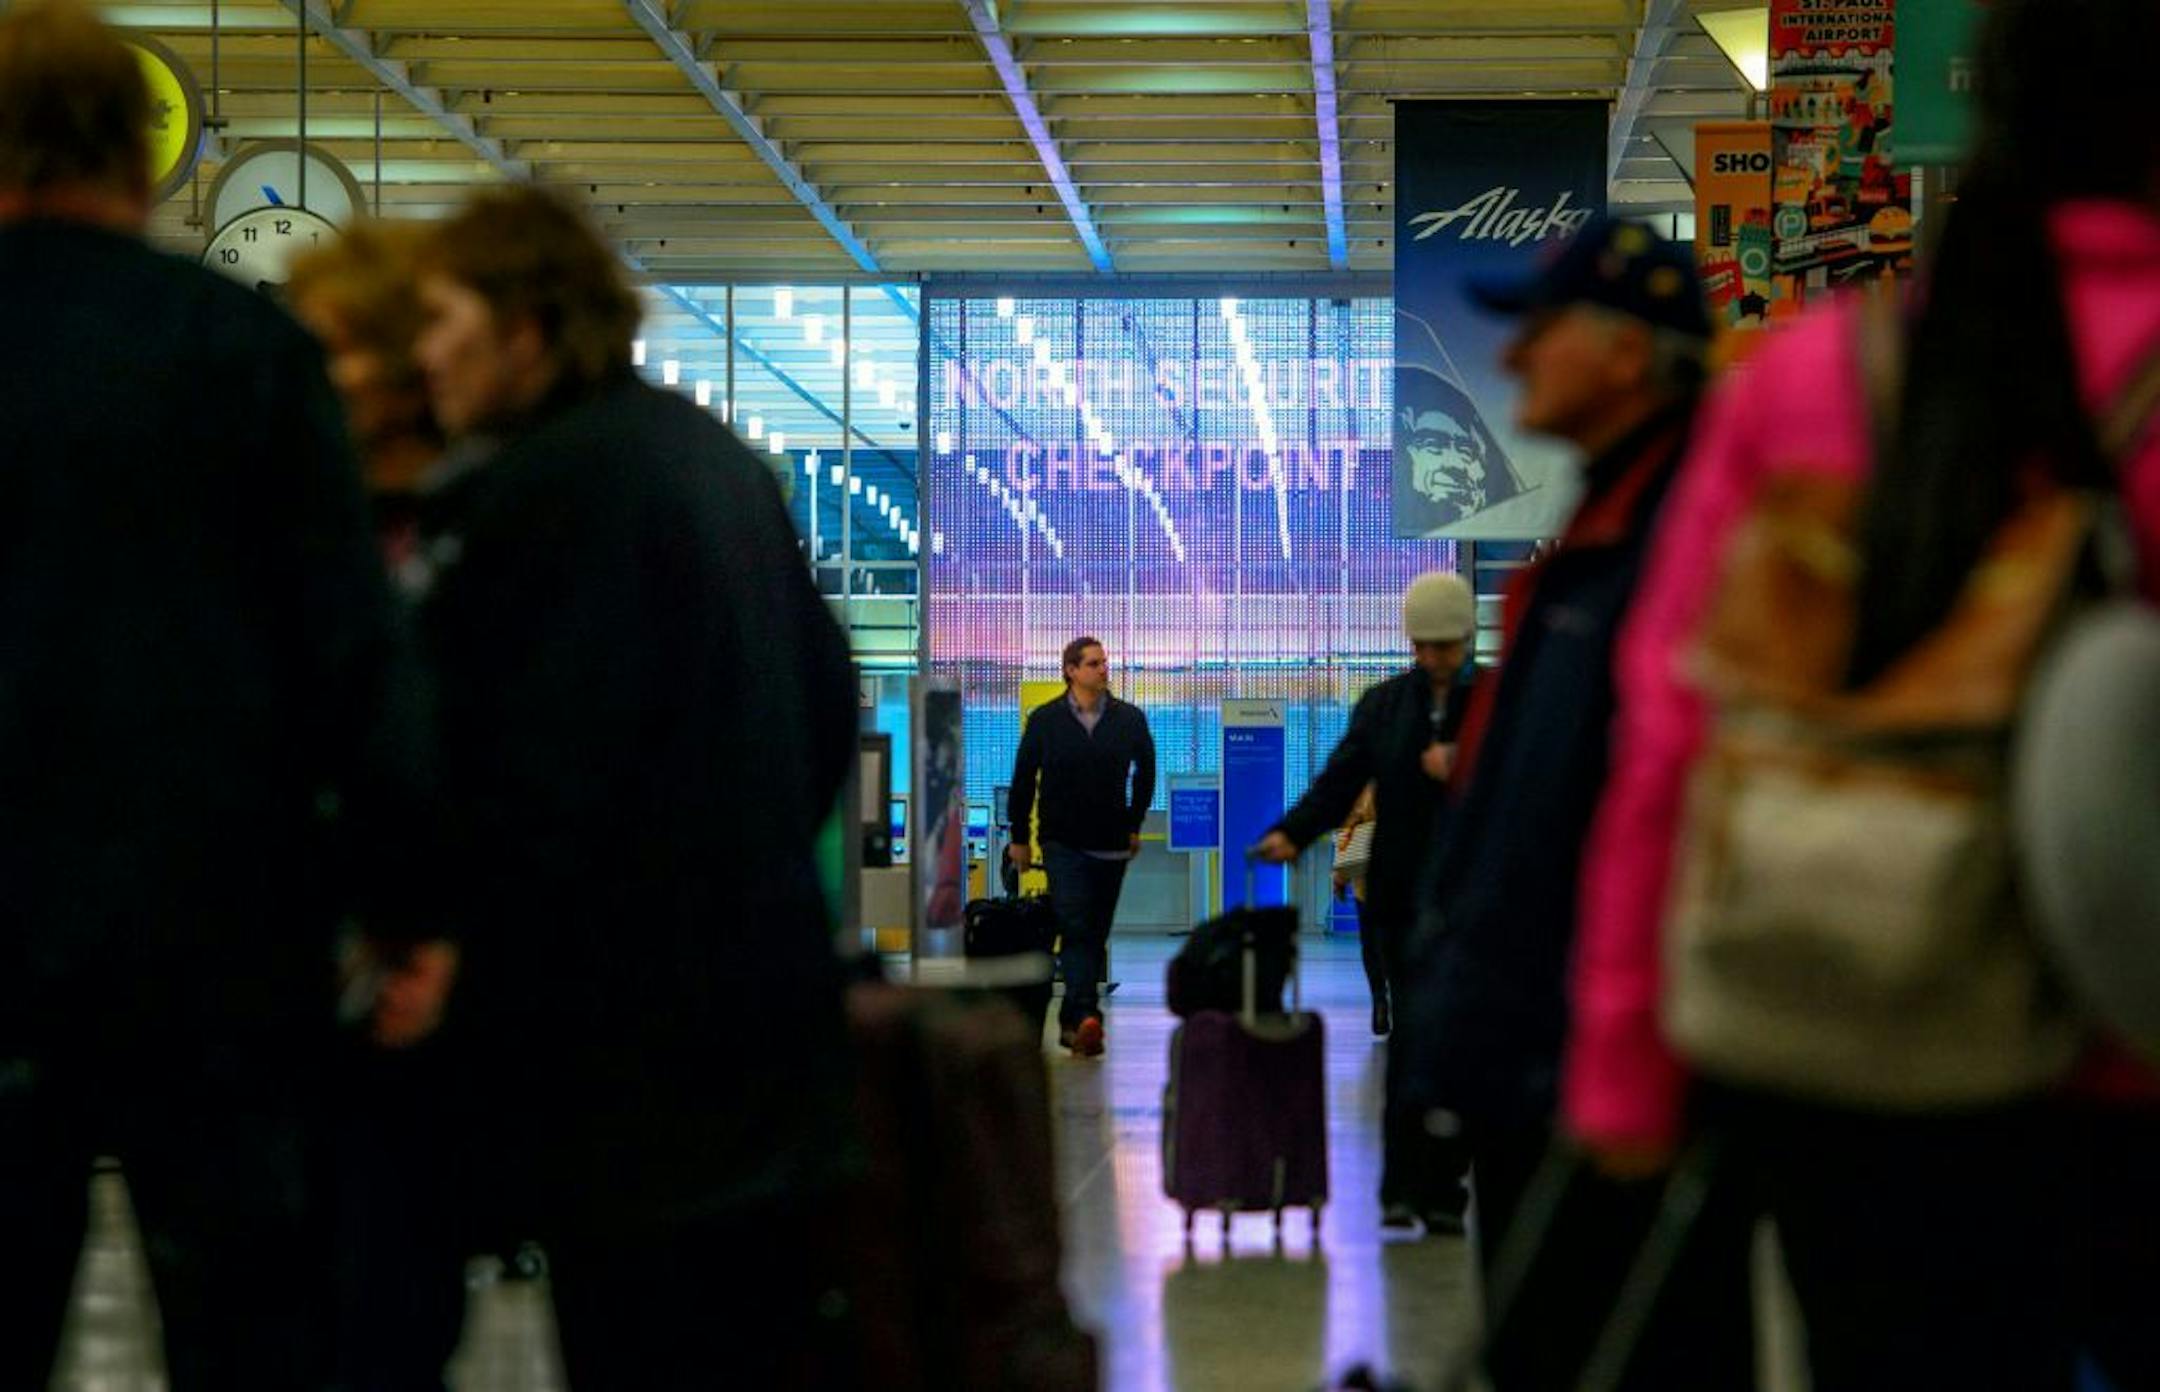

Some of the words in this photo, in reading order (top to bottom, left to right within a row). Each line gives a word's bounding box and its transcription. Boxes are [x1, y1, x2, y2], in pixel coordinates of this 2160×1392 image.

[1783, 13, 1893, 25] INTERNATIONA
[1806, 28, 1880, 41] AIRPORT
[1714, 153, 1770, 172] SHO
[1407, 186, 1595, 248] Alaska
[242, 227, 257, 242] 11
[274, 219, 292, 235] 12
[220, 248, 239, 264] 10
[942, 358, 1134, 408] NORTH
[1155, 358, 1395, 408] SECURIT
[1006, 440, 1362, 491] CHECKPOINT
